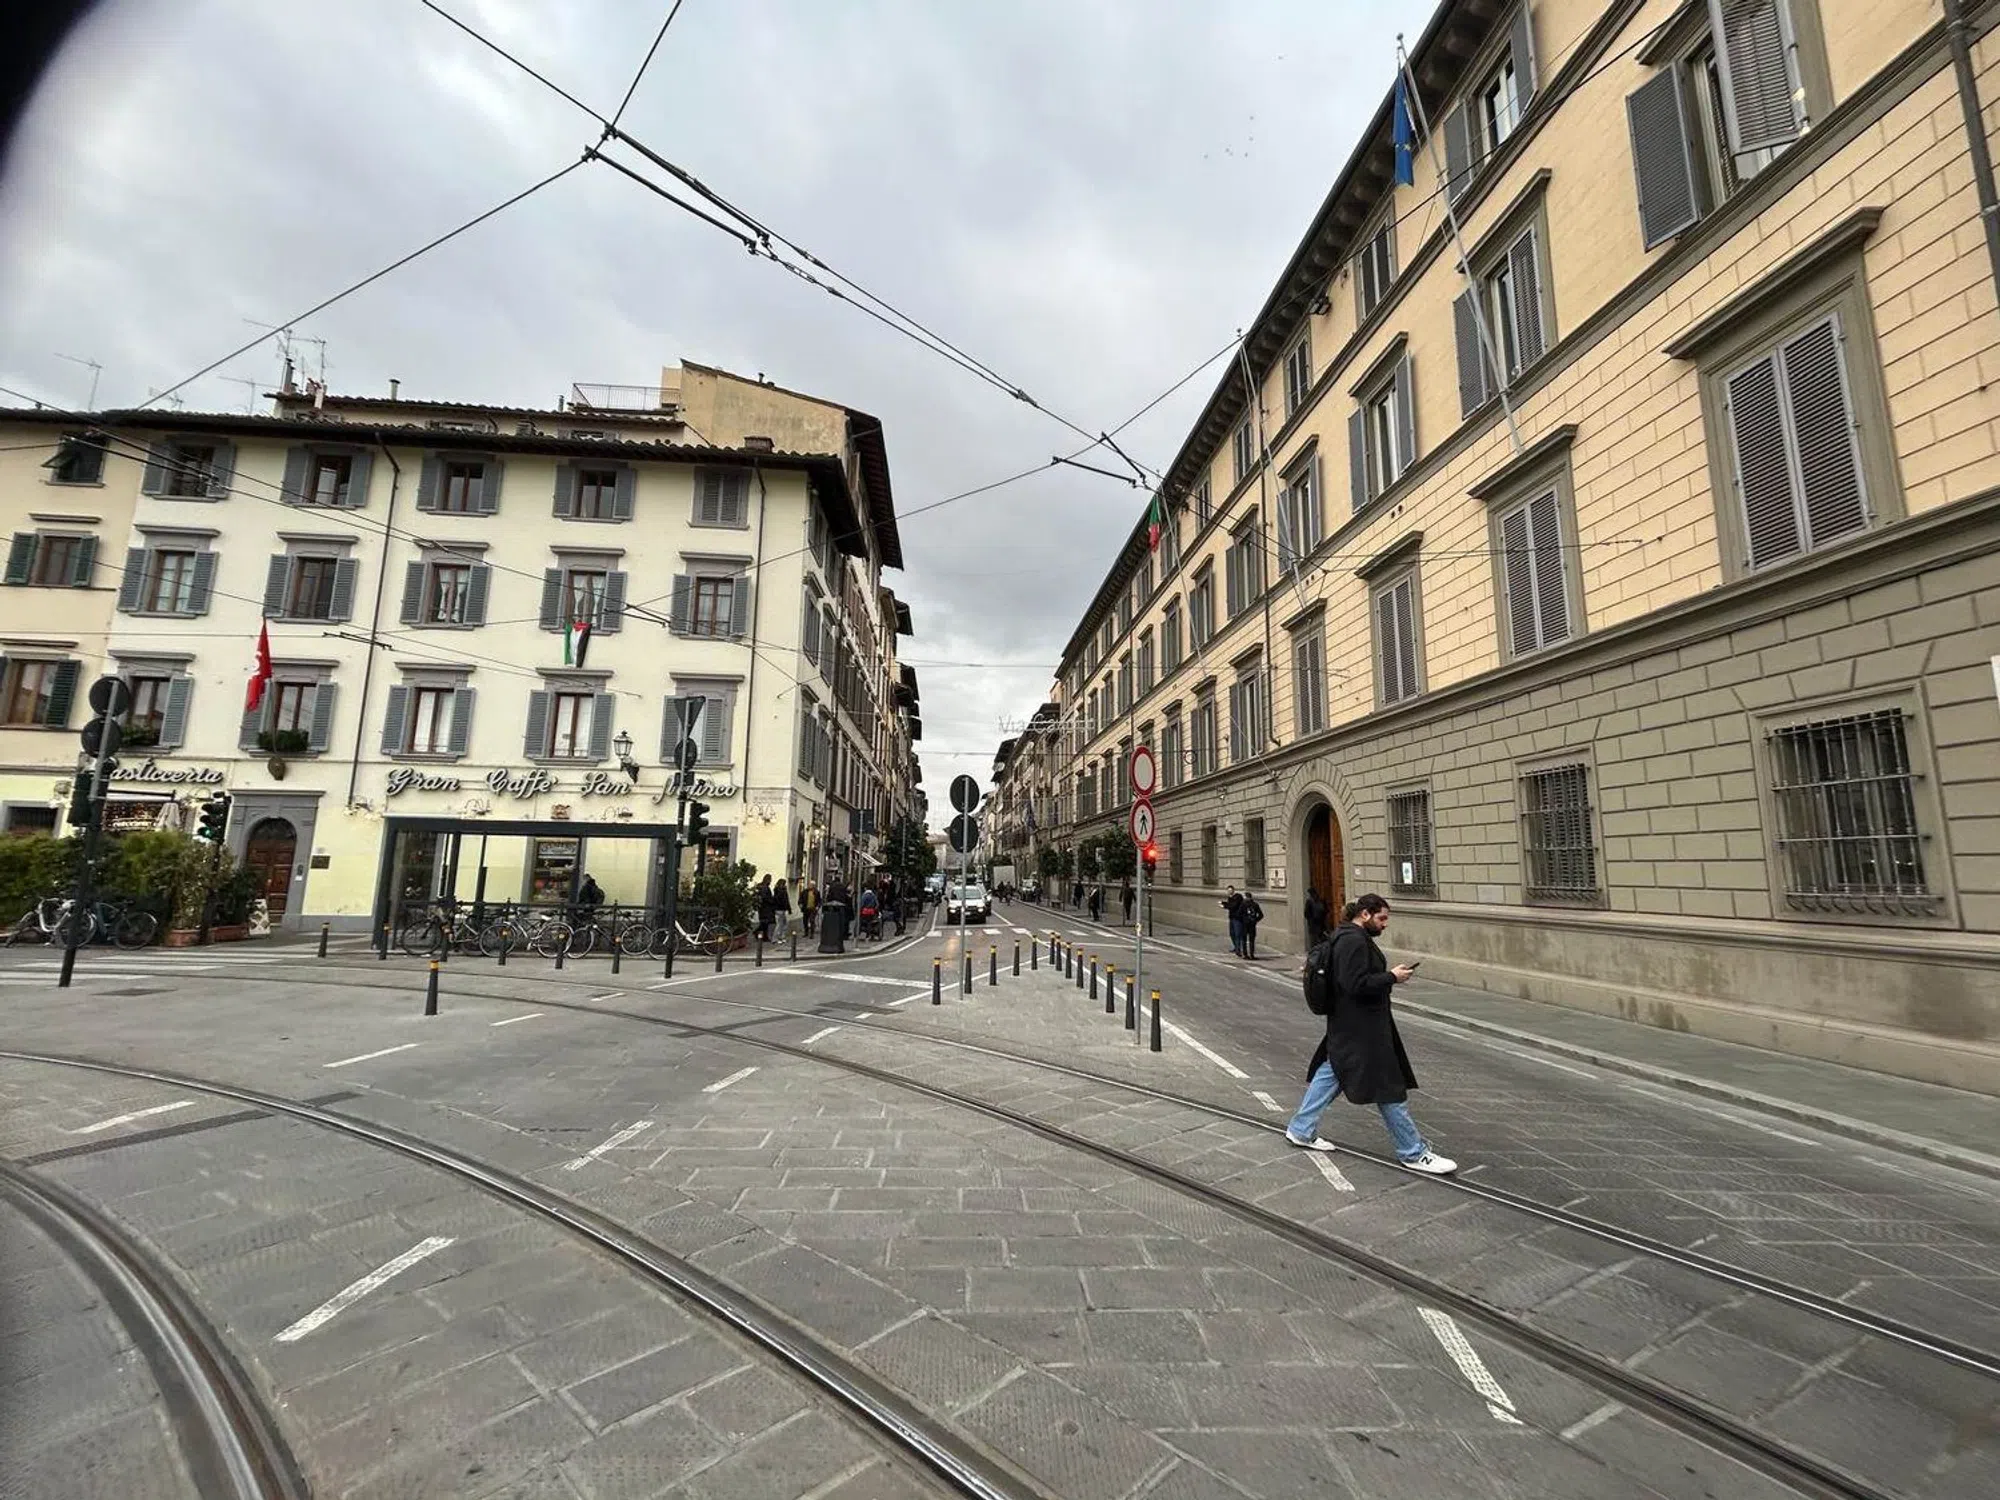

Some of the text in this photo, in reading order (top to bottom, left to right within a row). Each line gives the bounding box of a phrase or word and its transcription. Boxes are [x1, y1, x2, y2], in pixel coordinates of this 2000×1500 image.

[108, 758, 224, 784] asticceria
[387, 766, 461, 796] Gran
[581, 772, 630, 797] San
[1421, 1156, 1433, 1165] N
